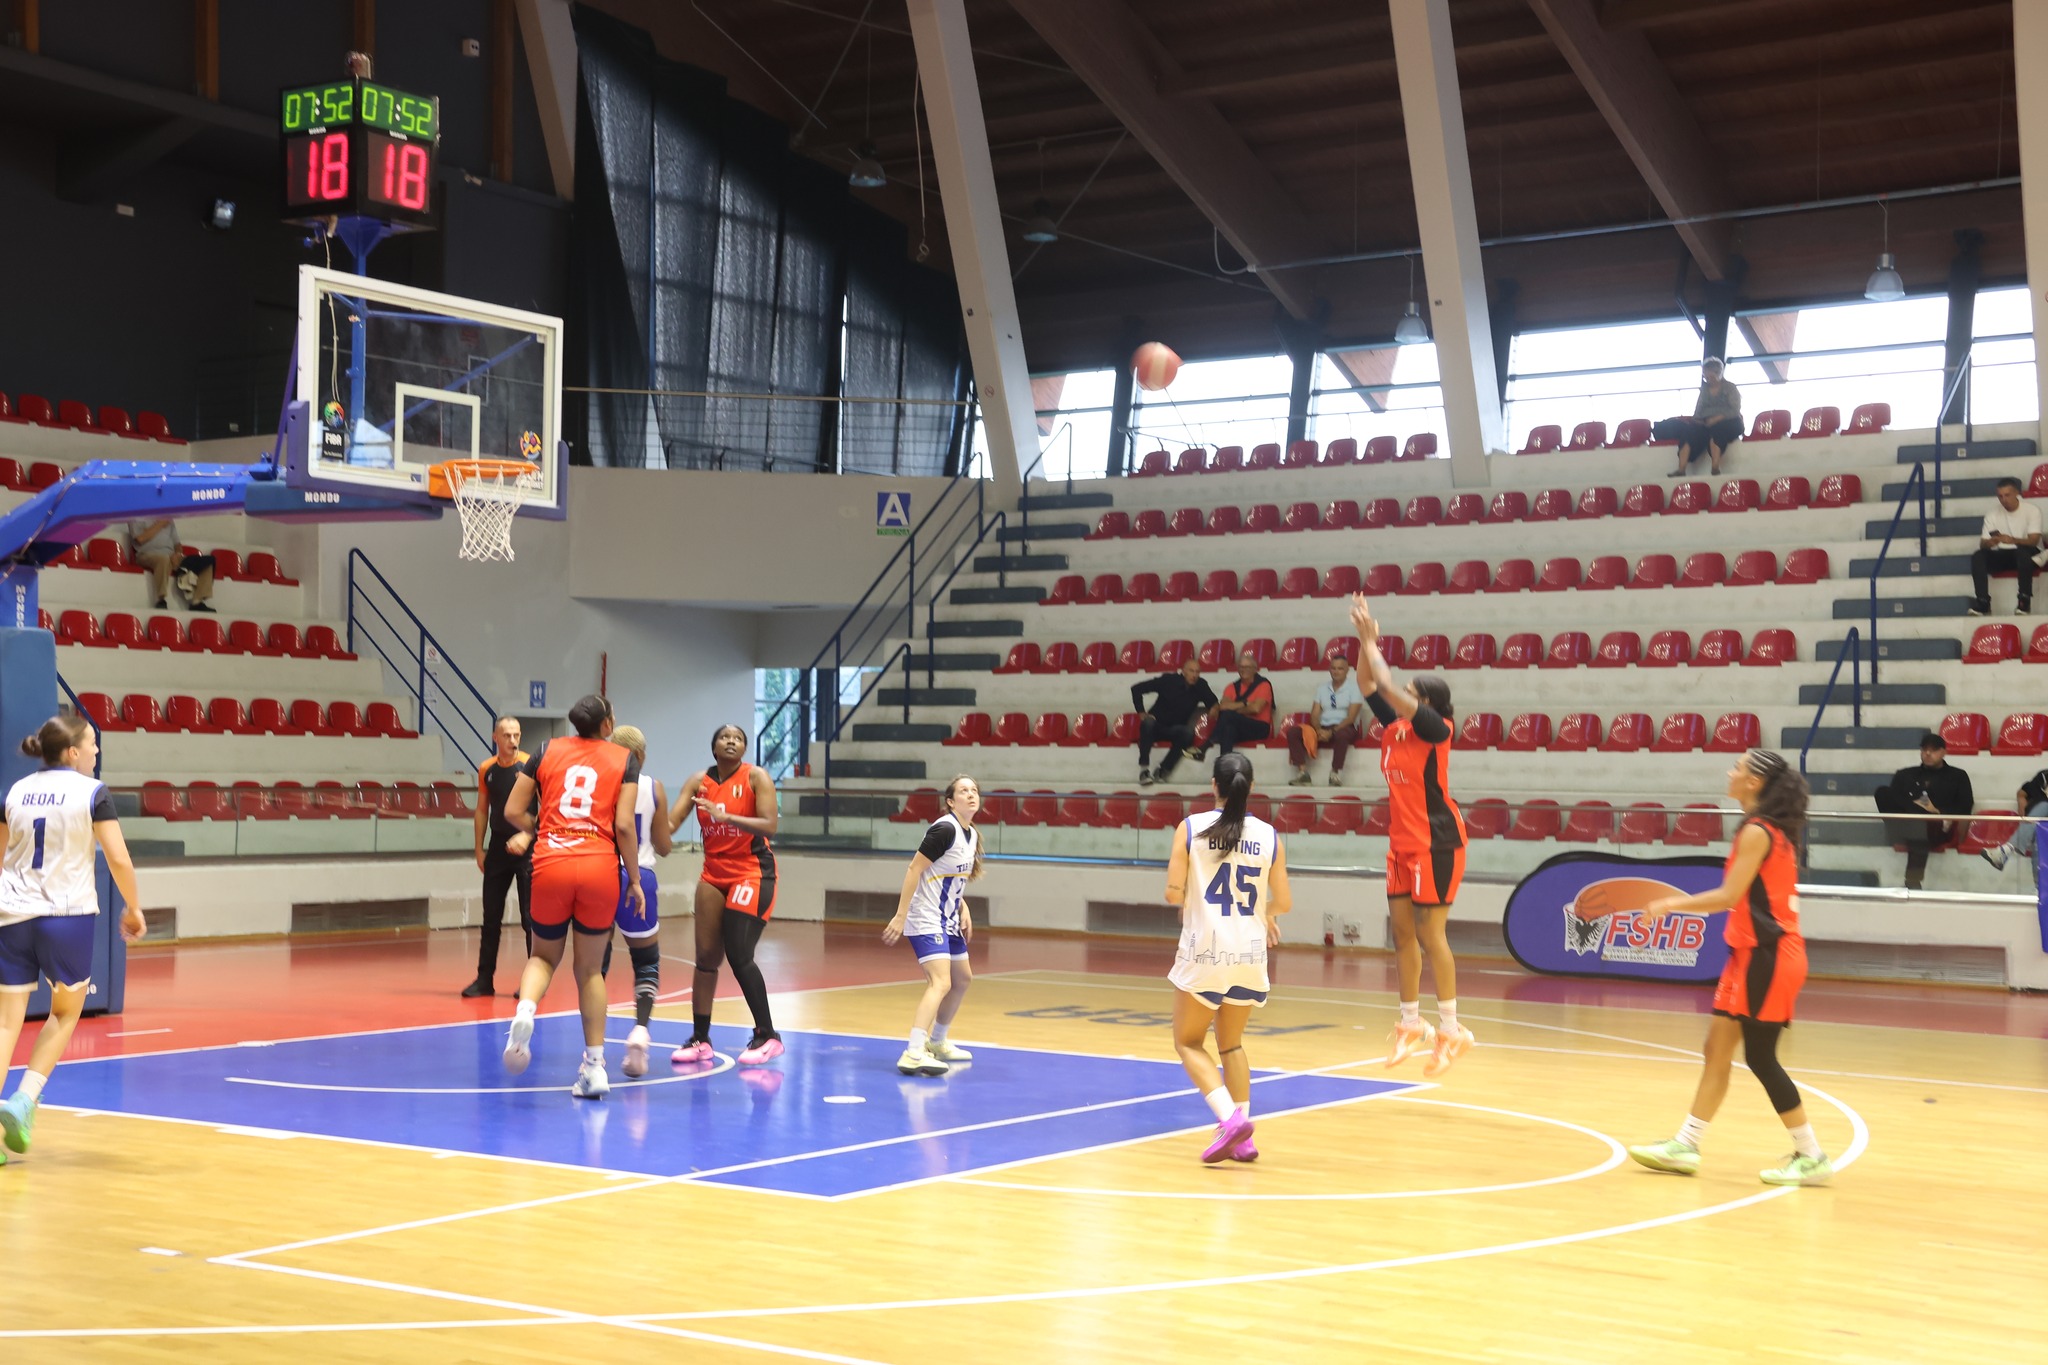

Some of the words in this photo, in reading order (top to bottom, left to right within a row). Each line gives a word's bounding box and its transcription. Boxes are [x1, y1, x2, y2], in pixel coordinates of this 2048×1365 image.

[285, 86, 353, 129] 07:52
[361, 86, 433, 136] 07:52
[308, 133, 349, 199] 18
[384, 143, 427, 210] 18
[191, 488, 226, 501] MONDO
[304, 491, 340, 504] MONDO
[878, 492, 909, 526] A
[15, 584, 26, 630] MONDO
[558, 764, 598, 819] 8
[31, 817, 46, 869] 1
[731, 883, 754, 906] 10
[1204, 862, 1262, 917] 45
[1605, 914, 1706, 950] FSHB
